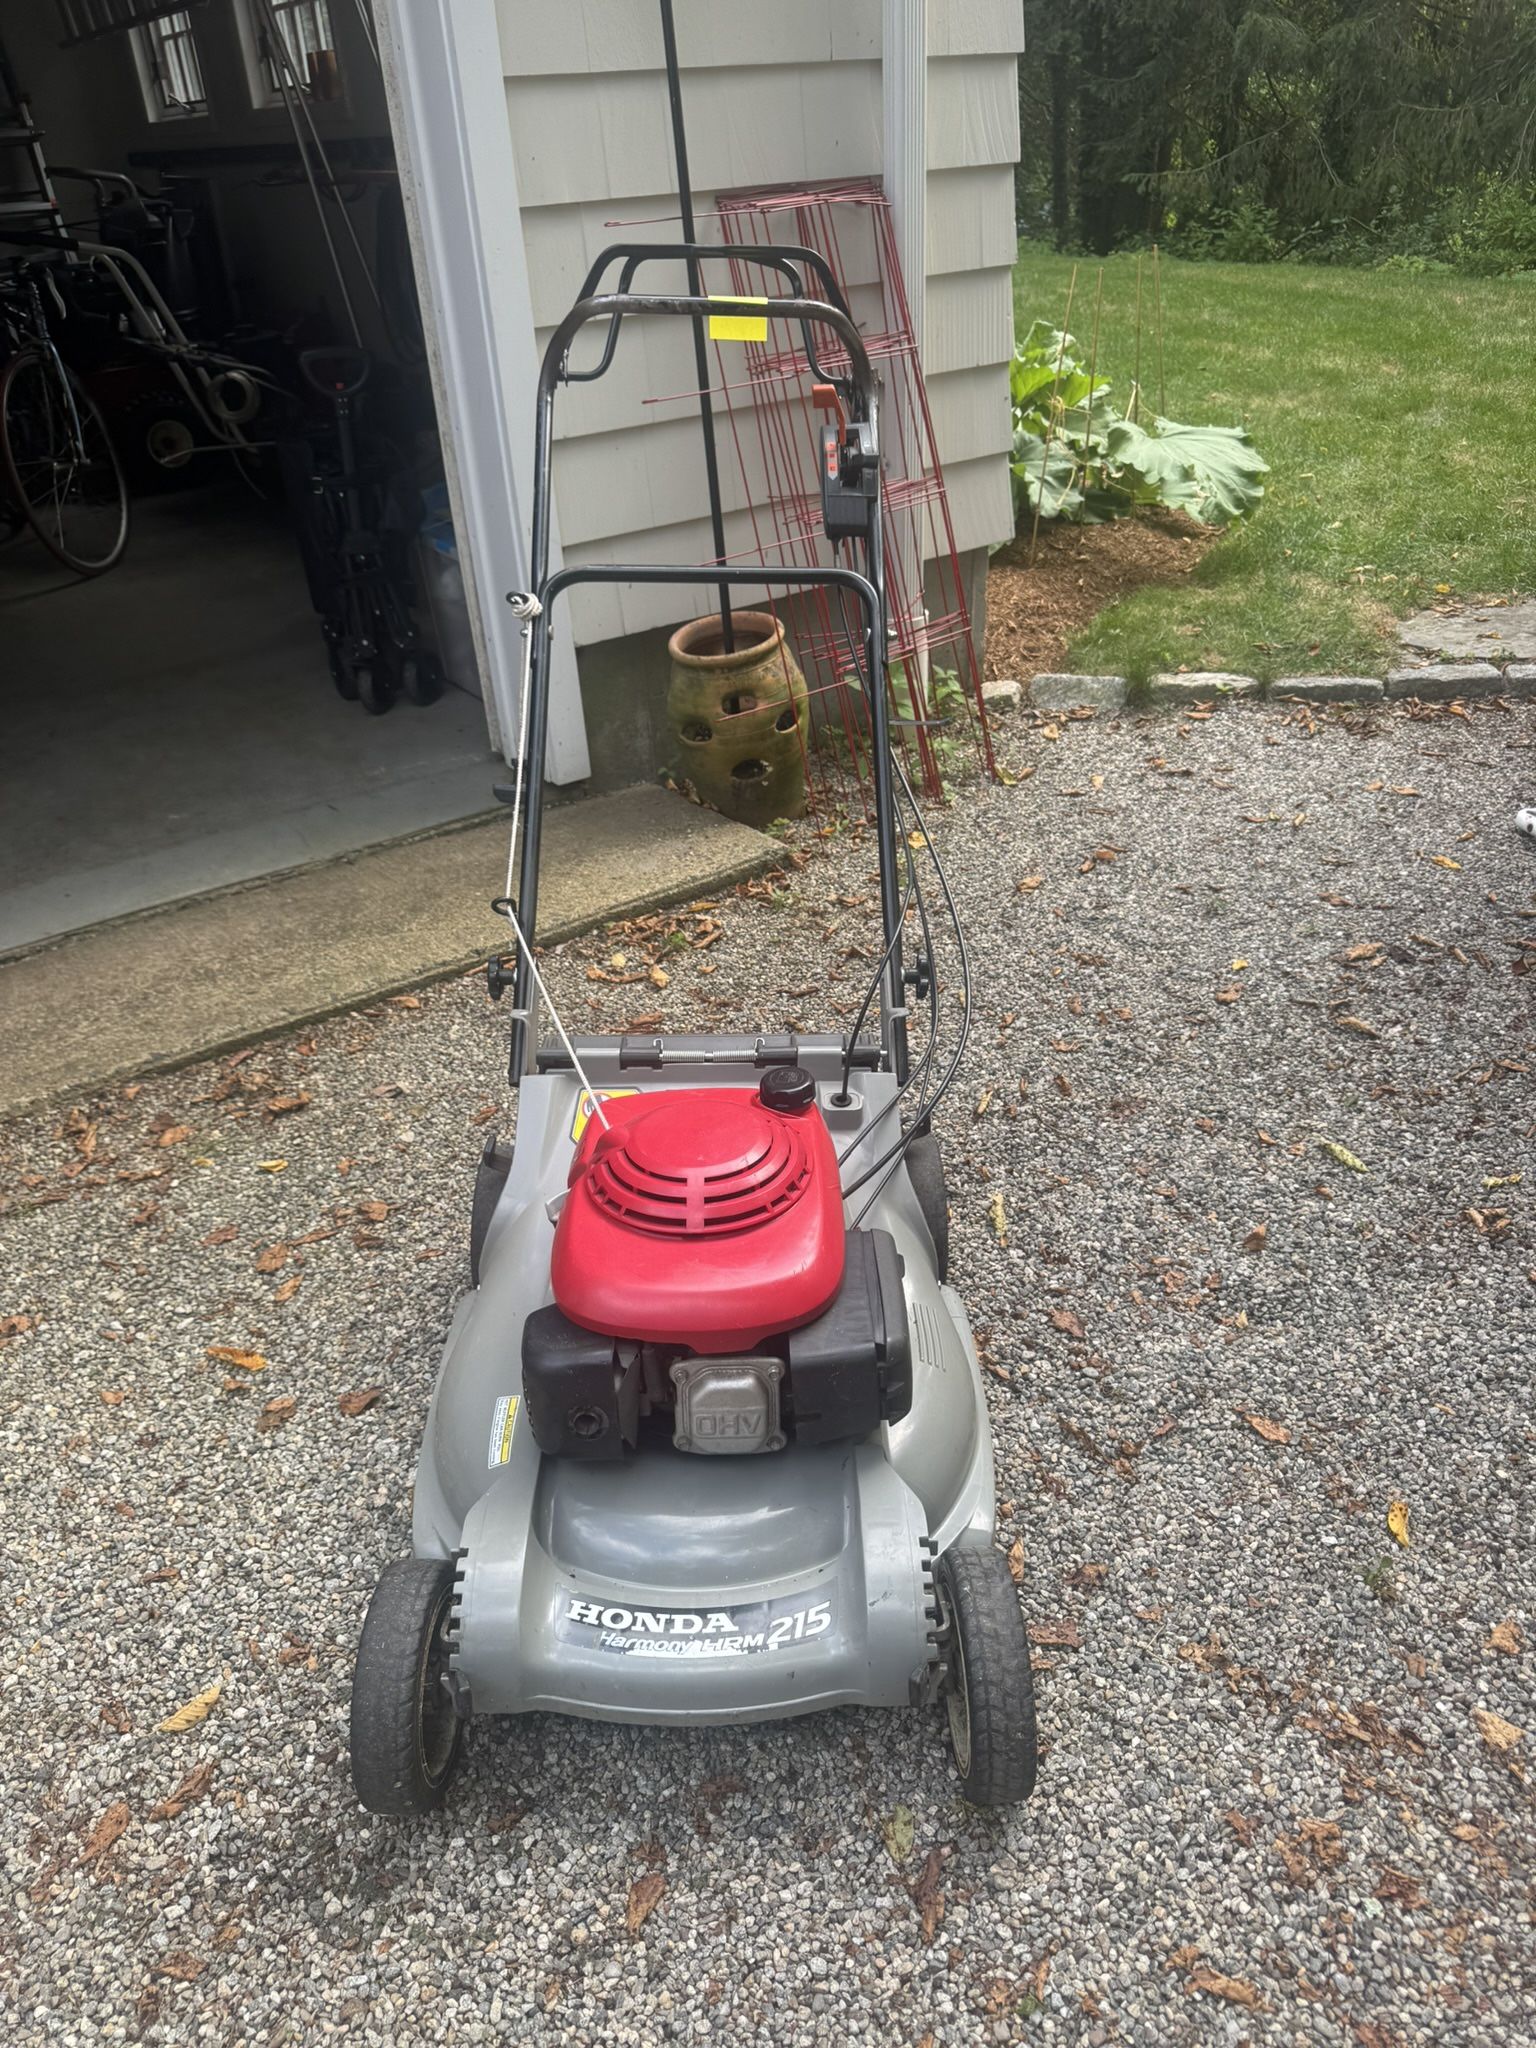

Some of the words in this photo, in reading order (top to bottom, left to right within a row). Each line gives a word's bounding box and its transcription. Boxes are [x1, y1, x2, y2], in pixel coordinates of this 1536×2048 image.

[695, 1413, 762, 1436] OHV
[565, 1599, 739, 1634] HONDA
[766, 1600, 832, 1645] 215
